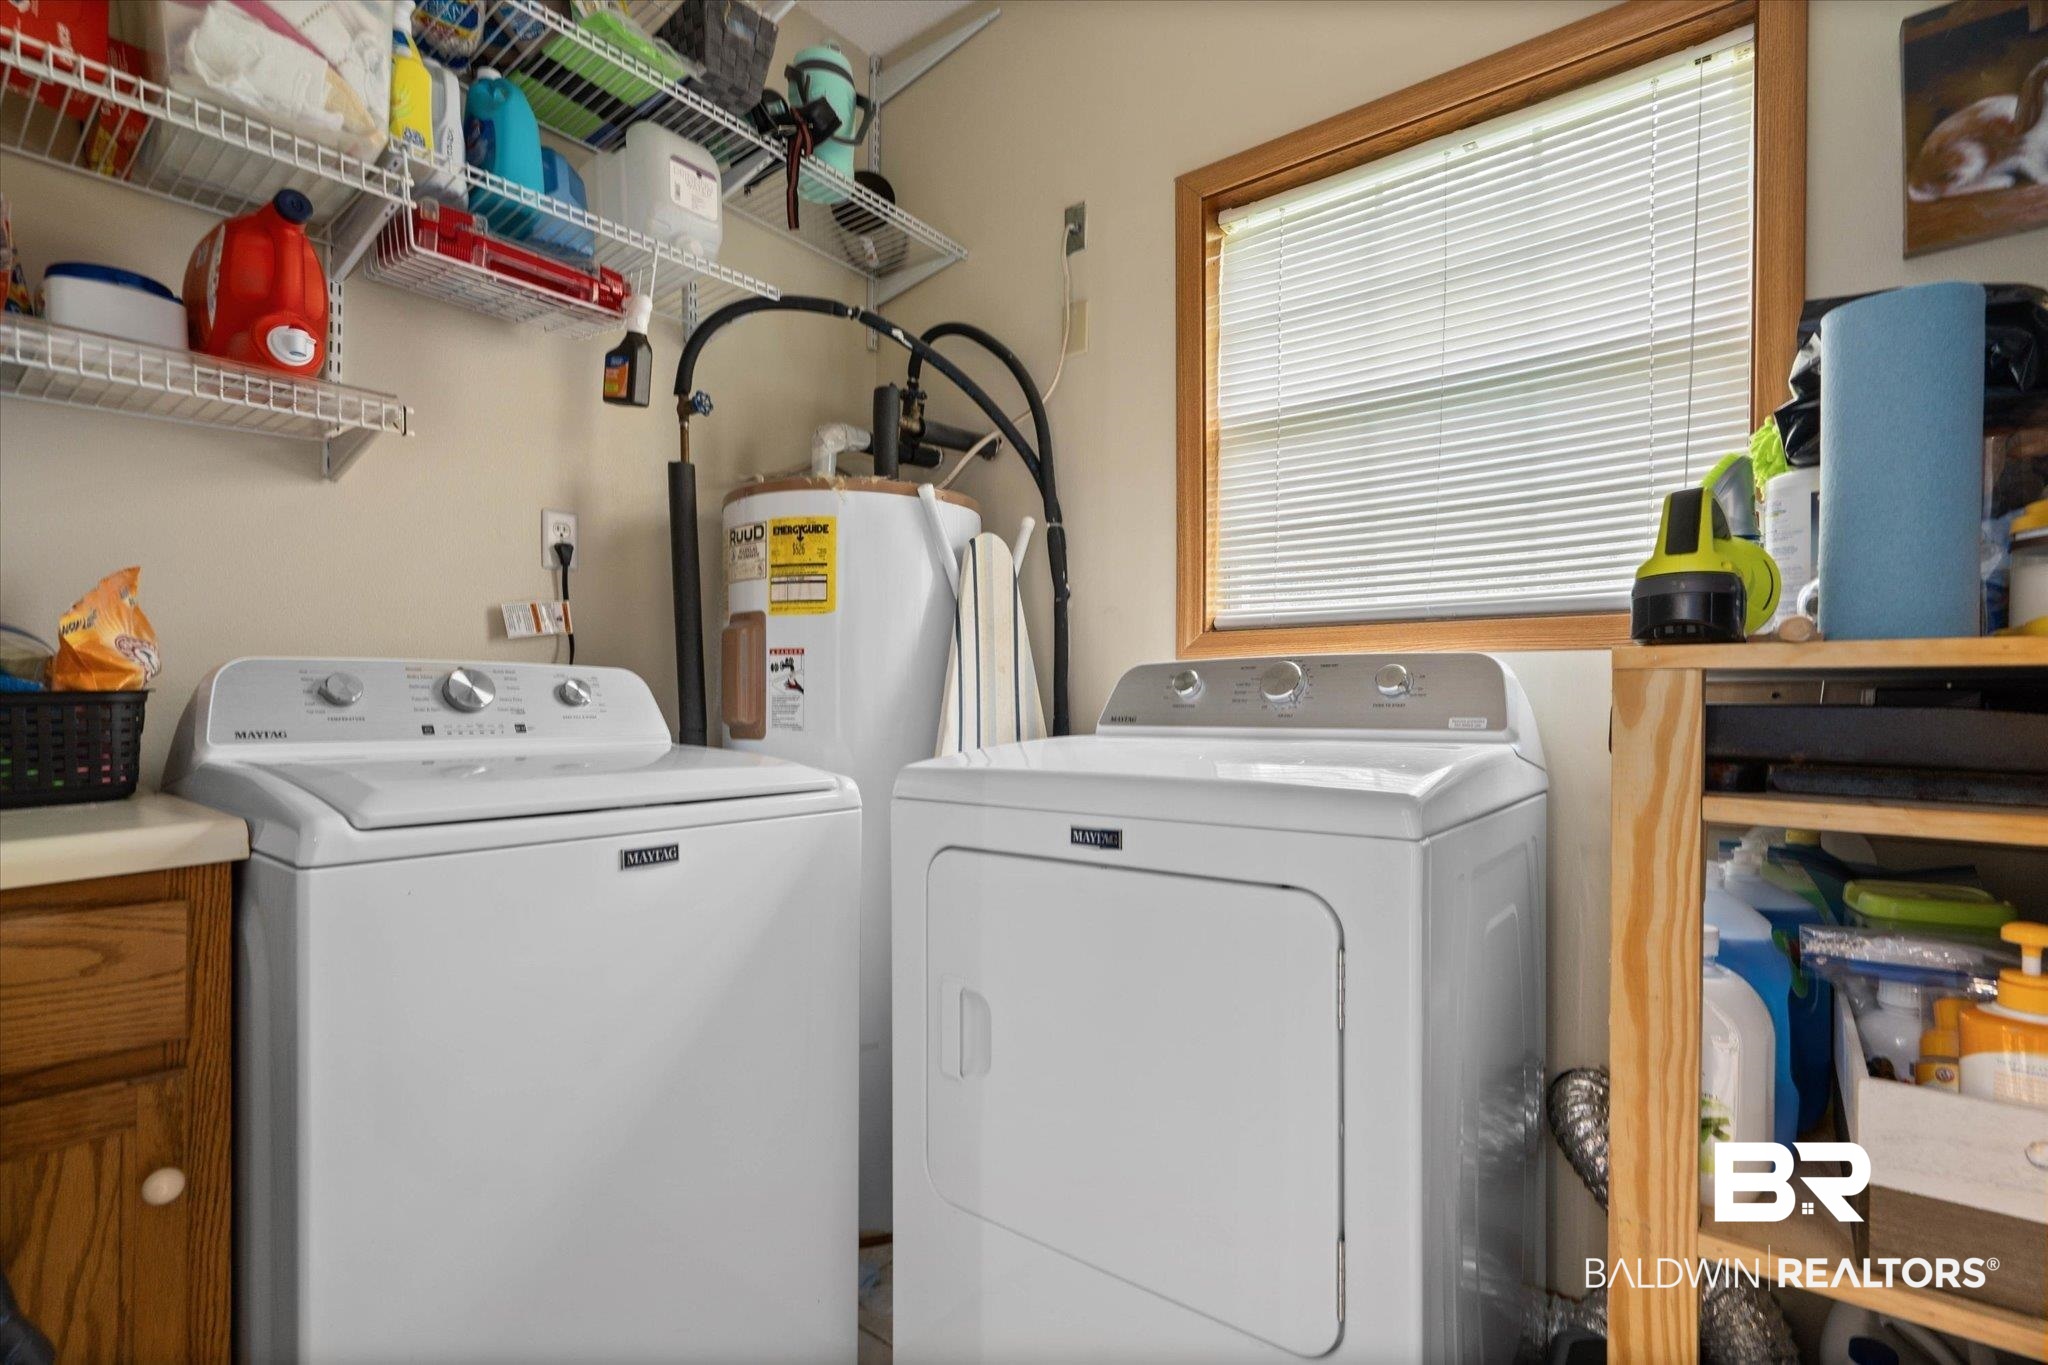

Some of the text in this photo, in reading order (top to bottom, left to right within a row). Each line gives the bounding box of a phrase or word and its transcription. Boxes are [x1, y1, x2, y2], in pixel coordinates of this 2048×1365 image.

[730, 525, 764, 544] RUUD
[234, 730, 287, 739] MAYTAG
[1073, 830, 1118, 846] MAYTAG
[627, 846, 677, 865] MAYTAG
